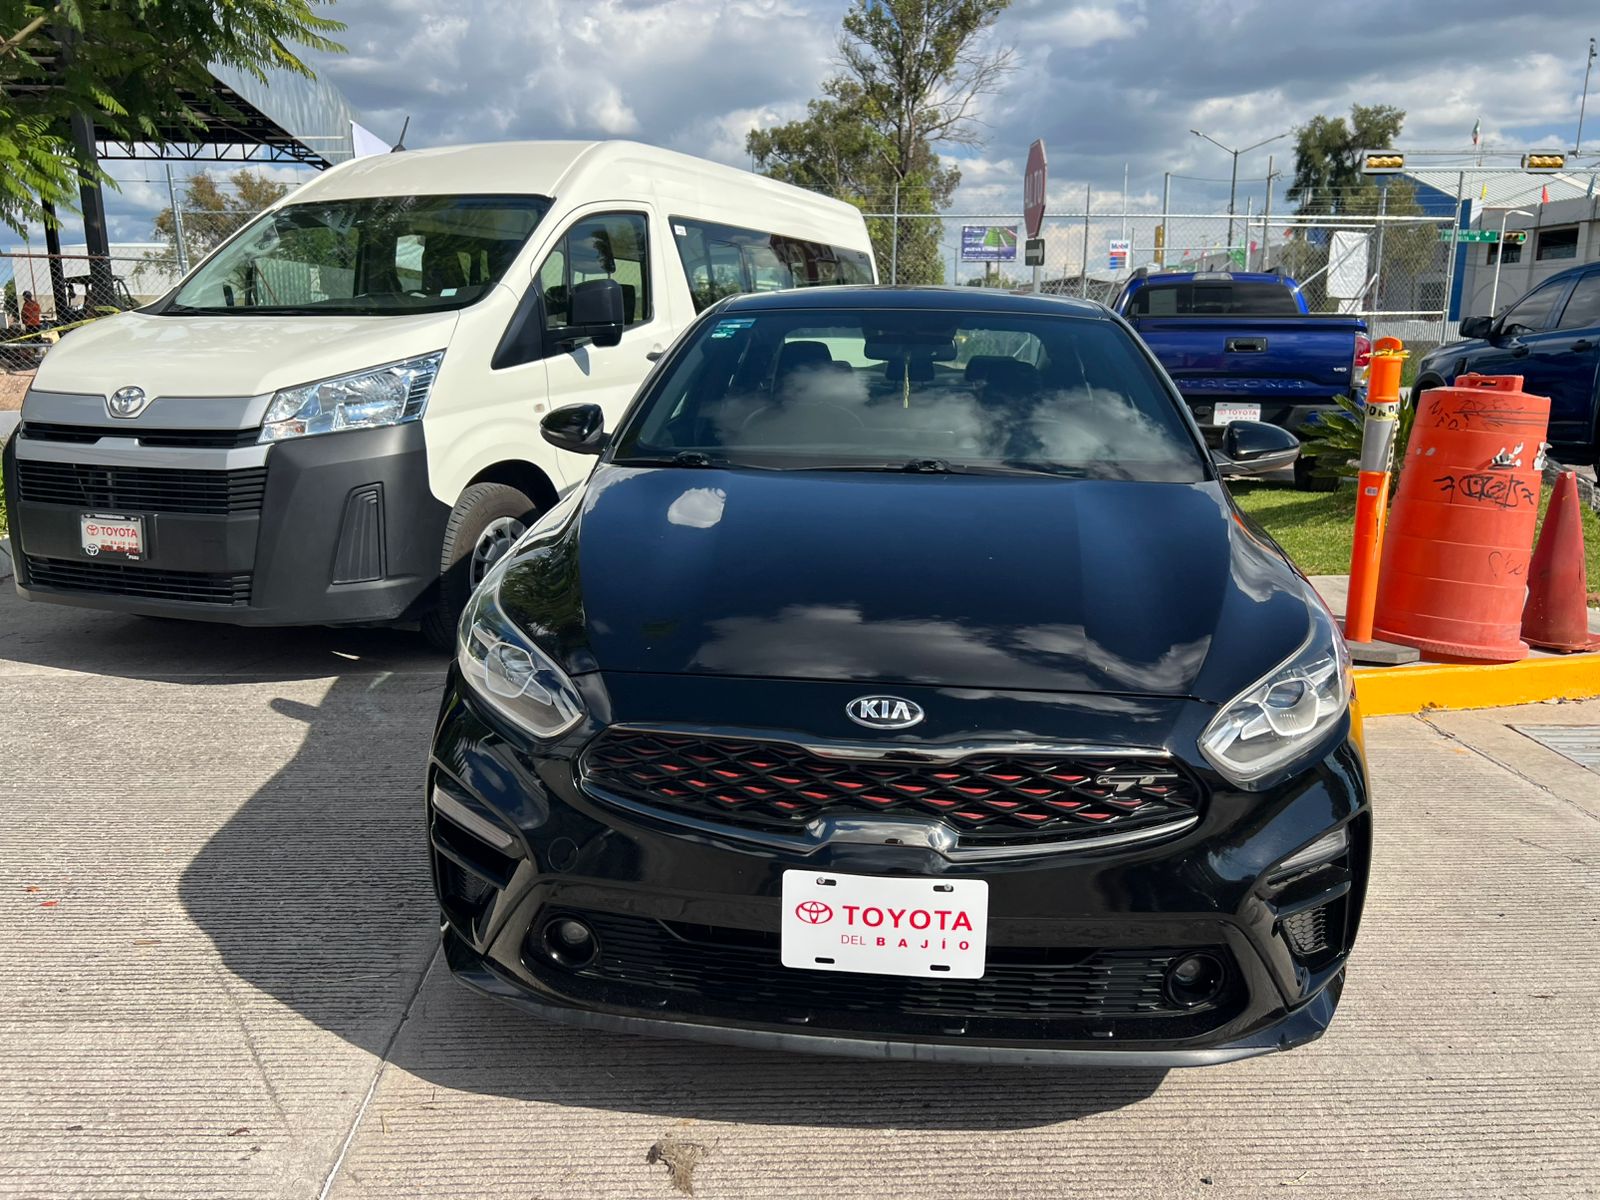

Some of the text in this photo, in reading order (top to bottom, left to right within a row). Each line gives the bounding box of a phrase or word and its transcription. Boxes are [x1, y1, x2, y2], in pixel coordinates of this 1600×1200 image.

[1024, 169, 1043, 208] ALTO
[1180, 379, 1304, 388] TACOMA
[100, 526, 138, 538] TOYOTA
[860, 700, 911, 720] KIA
[842, 905, 973, 931] TOYOTA
[841, 934, 970, 951] DEL BAJÍO
